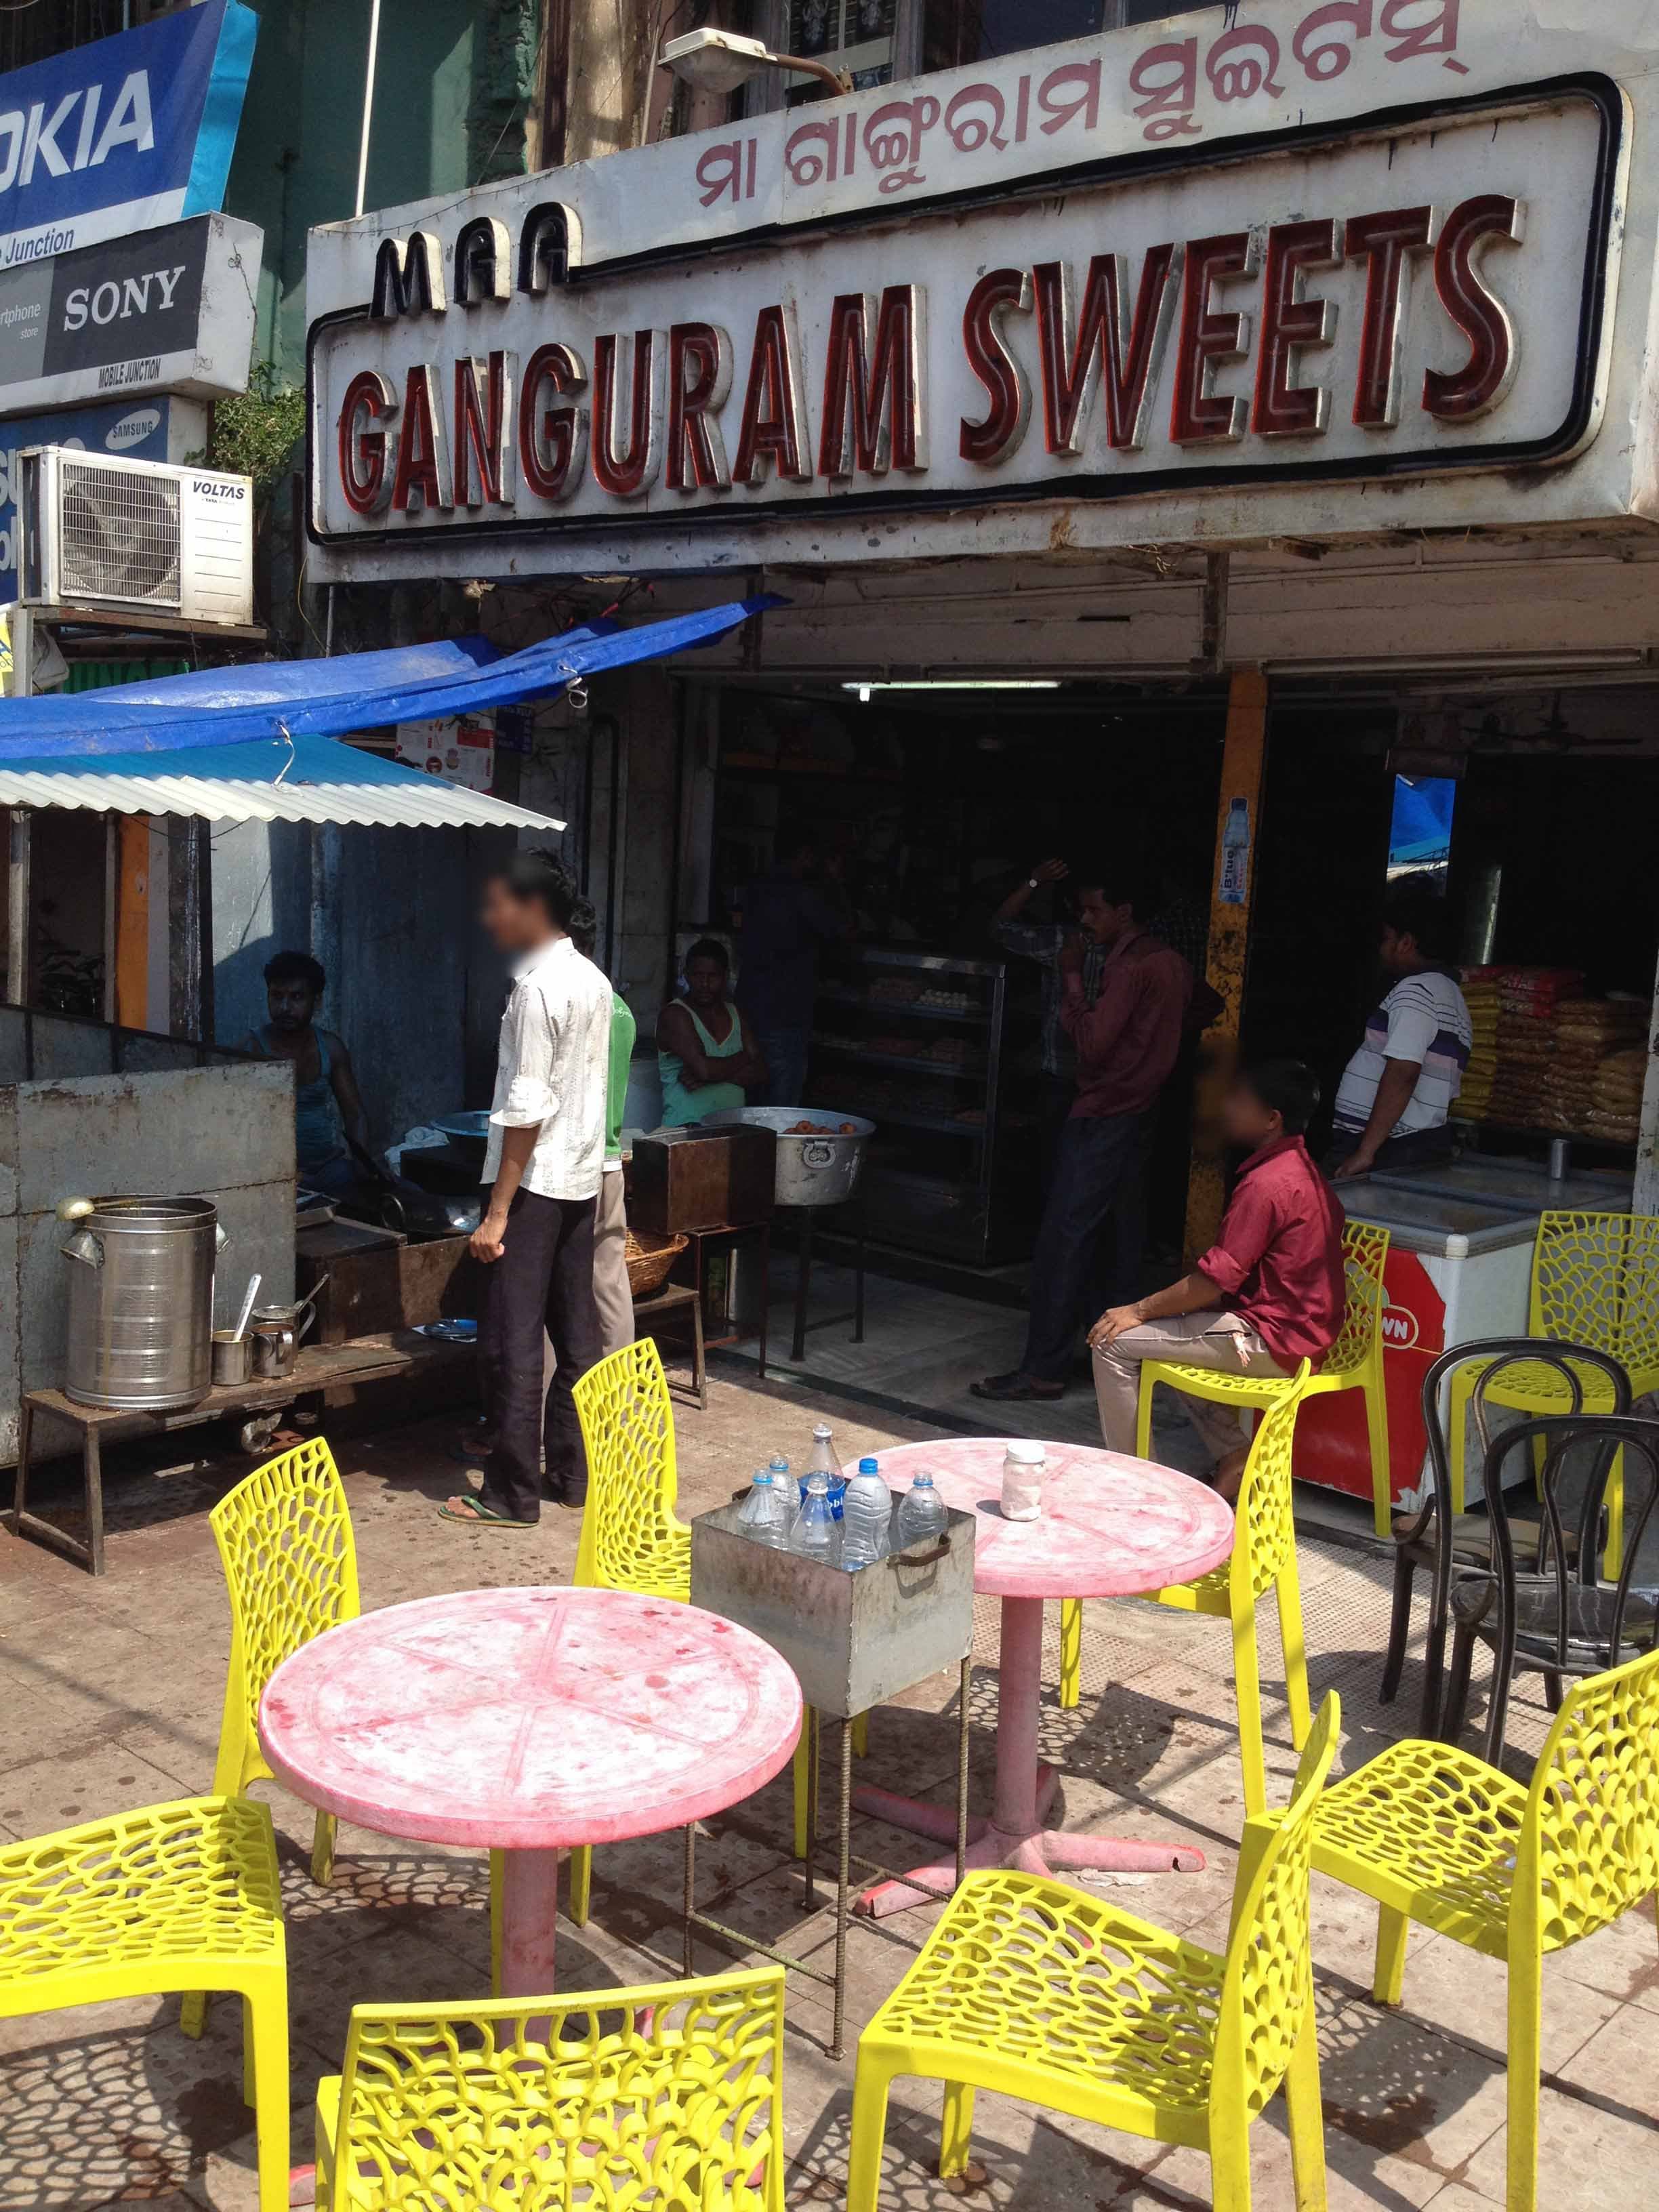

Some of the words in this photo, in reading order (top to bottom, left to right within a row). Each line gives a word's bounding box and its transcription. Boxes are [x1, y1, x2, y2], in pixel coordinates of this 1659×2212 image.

[695, 138, 757, 207] ମା
[5, 228, 75, 263] Junction
[369, 202, 583, 320] MAA
[64, 266, 186, 331] SONY
[20, 327, 39, 339] store
[339, 283, 928, 514] GANGURAM
[960, 194, 1526, 466] SWEETS
[99, 365, 124, 389] MOBILE
[125, 359, 161, 382] JUNCTION
[113, 421, 153, 438] SAMSUNG
[193, 481, 245, 499] VOLTAS
